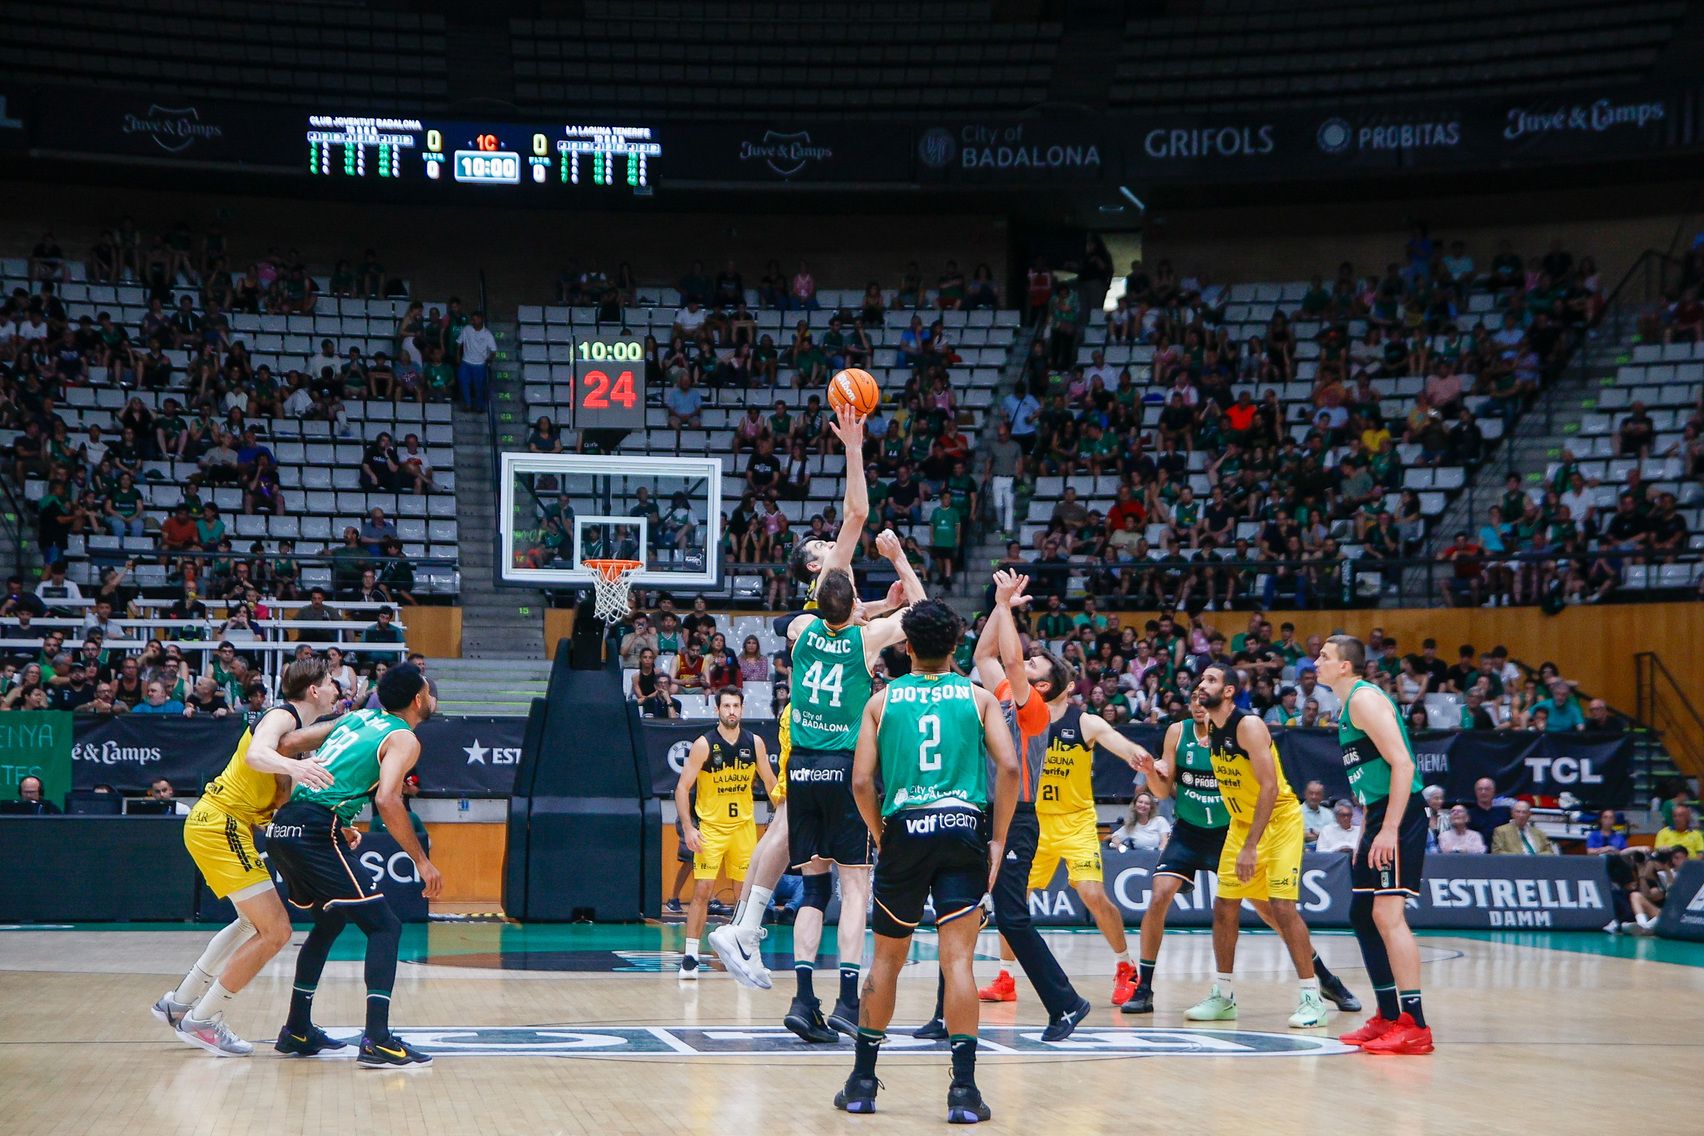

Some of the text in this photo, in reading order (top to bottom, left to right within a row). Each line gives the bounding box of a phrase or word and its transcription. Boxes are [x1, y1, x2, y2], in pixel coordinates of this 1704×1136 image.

[1568, 104, 1588, 130] &
[1590, 97, 1664, 132] Camps
[428, 130, 441, 152] 0
[961, 123, 1024, 143] City of
[1144, 124, 1274, 158] GRIFOLS
[1358, 121, 1461, 150] PROBITAS
[533, 133, 547, 156] 0
[962, 145, 1101, 168] BADALONA
[427, 160, 440, 179] 0
[461, 157, 516, 178] 10:00
[533, 164, 546, 183] 0
[578, 341, 642, 361] 10:00
[582, 370, 638, 408] 24
[806, 630, 852, 654] TOMIC
[801, 659, 845, 708] 44
[889, 684, 971, 704] DOTSON
[801, 718, 850, 733] BADALONA
[802, 710, 823, 721] City of
[101, 740, 161, 765] Camps
[918, 713, 943, 773] 2
[492, 747, 522, 765] EST
[1524, 756, 1604, 784] TCL
[1042, 784, 1059, 801] 21
[1184, 789, 1224, 804] JOVENT
[728, 802, 738, 818] 6
[1227, 796, 1242, 814] 11
[1205, 806, 1214, 825] 1
[1428, 878, 1604, 909] ESTRELLA
[1488, 909, 1552, 928] DAMM
